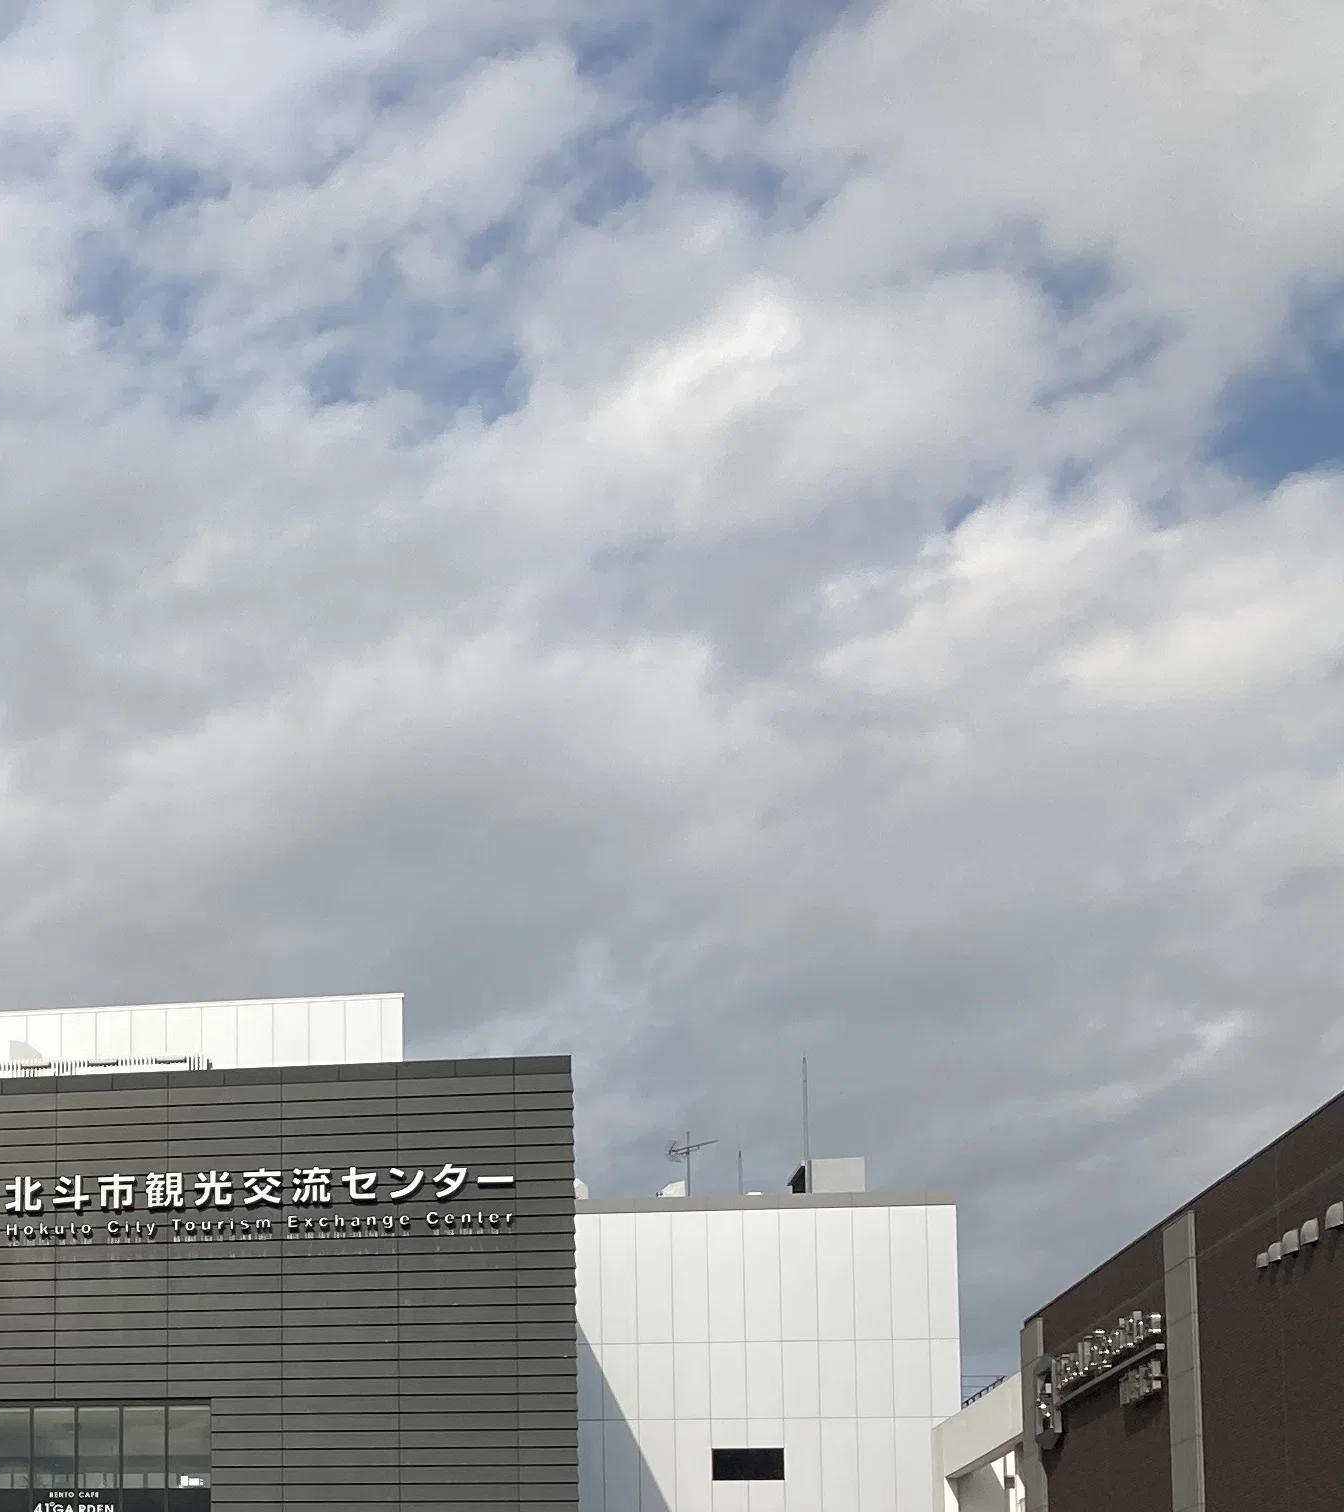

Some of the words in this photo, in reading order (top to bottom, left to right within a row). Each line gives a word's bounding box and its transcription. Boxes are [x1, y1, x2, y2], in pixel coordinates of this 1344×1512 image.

[5, 1164, 515, 1213] 北斗市観光交流センター
[6, 1222, 92, 1236] Hokuto
[107, 1220, 156, 1235] City
[172, 1217, 272, 1231] Tourism
[287, 1213, 410, 1229] Exchange
[426, 1211, 513, 1225] Center
